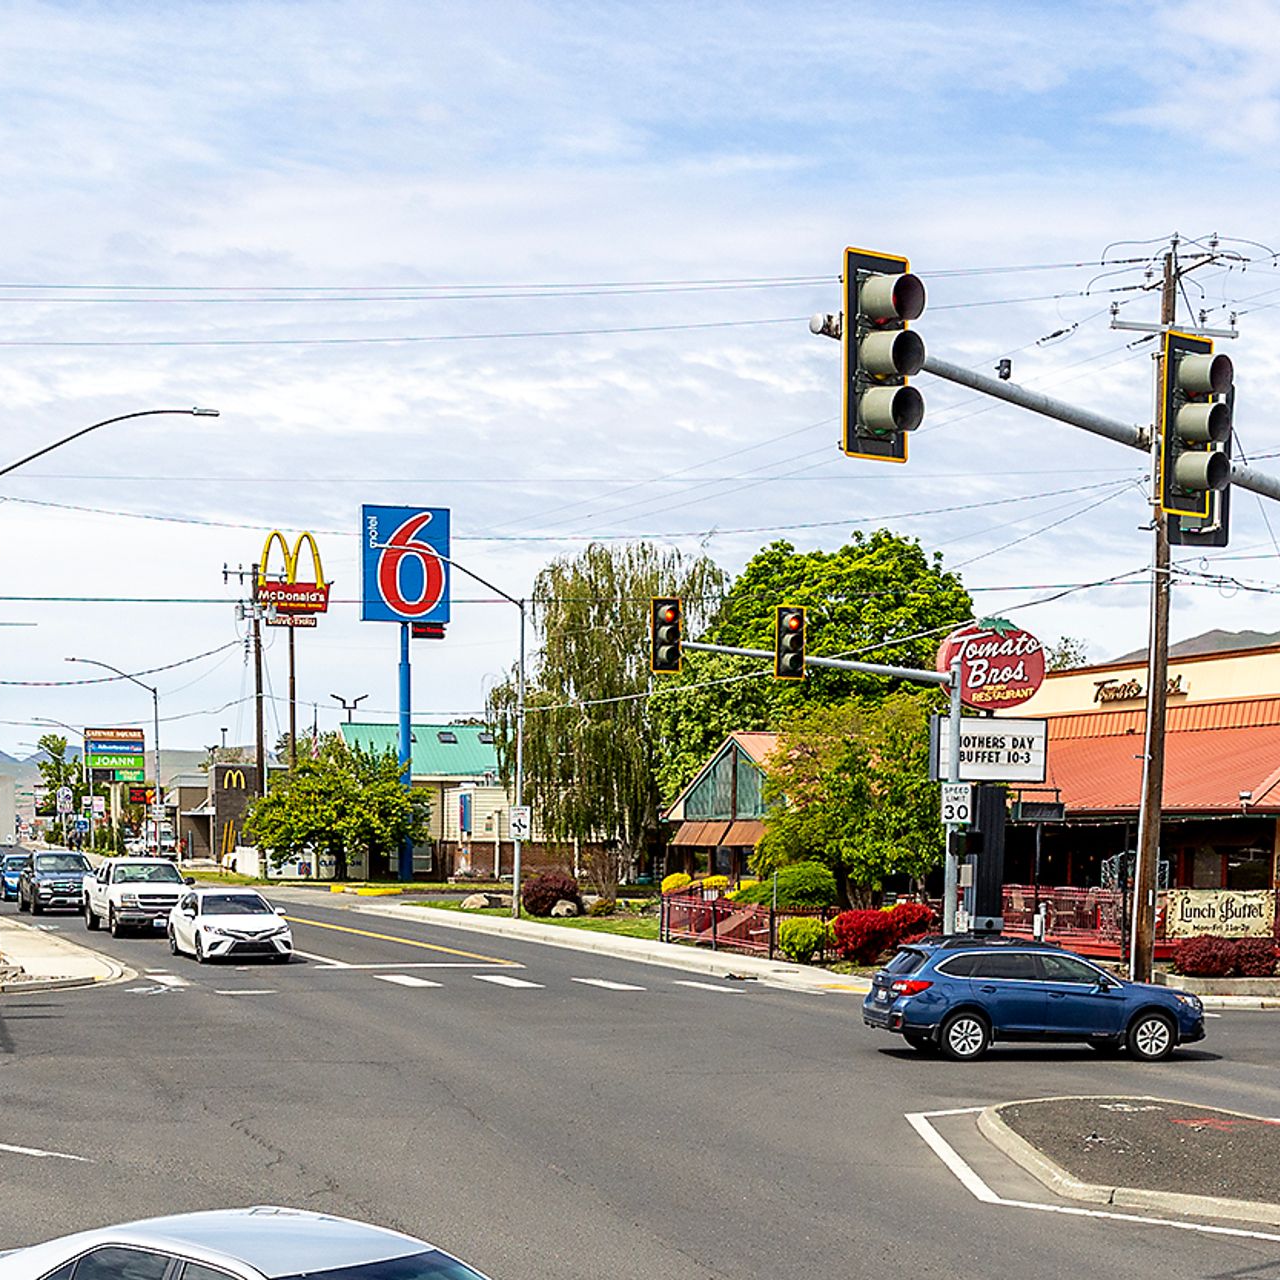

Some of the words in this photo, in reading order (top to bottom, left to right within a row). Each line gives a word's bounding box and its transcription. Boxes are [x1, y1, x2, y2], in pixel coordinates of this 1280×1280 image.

[367, 516, 380, 548] motel
[377, 511, 447, 618] 6
[258, 590, 325, 602] McDonald's
[950, 631, 1044, 659] Tomato
[966, 659, 1029, 688] Bros.
[972, 687, 1035, 703] RESTAURANT
[1012, 737, 1035, 749] DAY
[95, 755, 135, 766] JOANN
[960, 751, 1001, 763] BUFFET
[1007, 752, 1031, 764] 10-3
[944, 786, 969, 794] SPEED
[944, 805, 969, 820] 30
[1178, 896, 1216, 922] Lunch
[1219, 897, 1264, 923] Buffet
